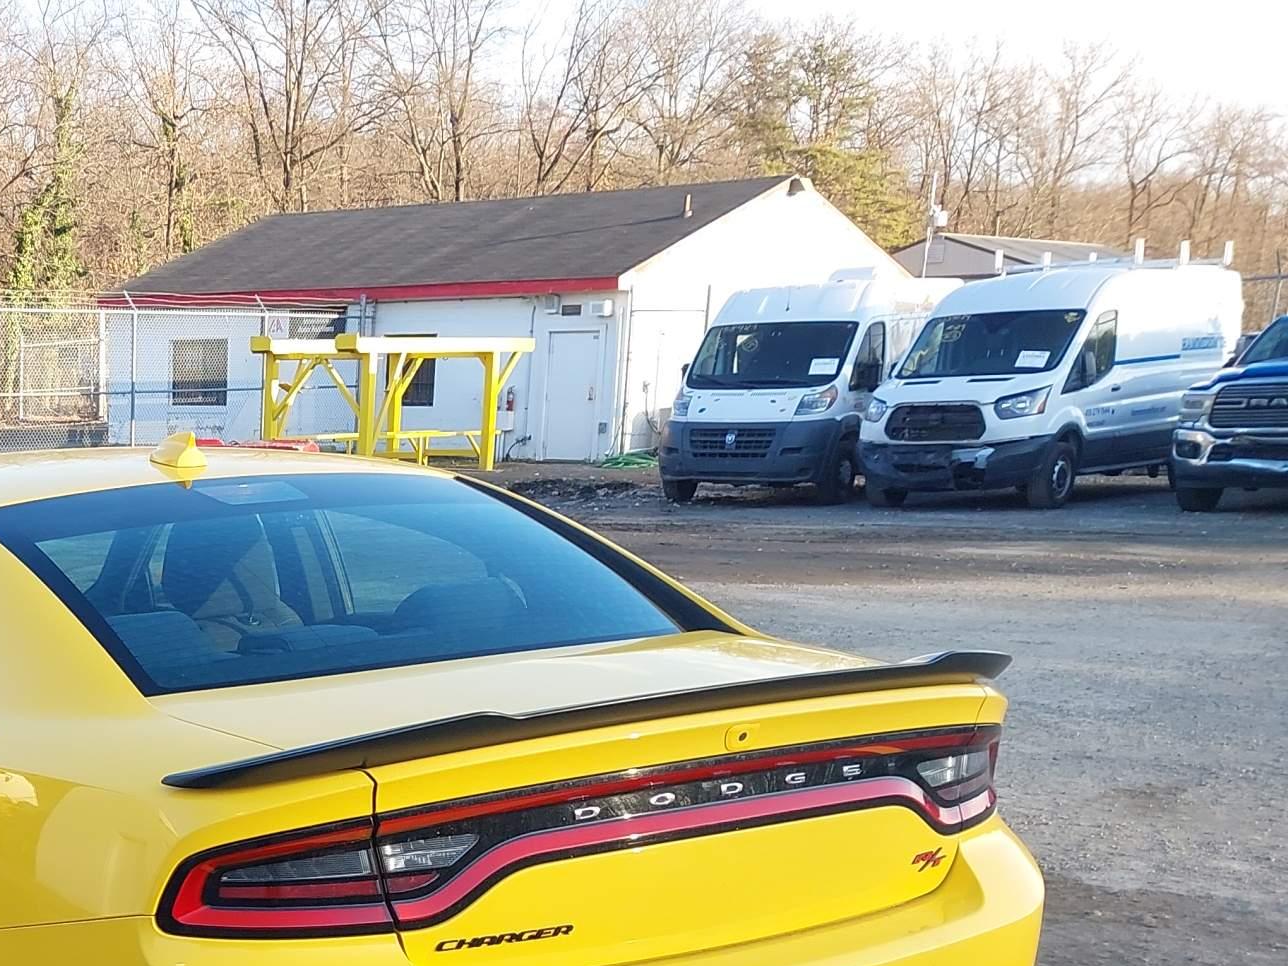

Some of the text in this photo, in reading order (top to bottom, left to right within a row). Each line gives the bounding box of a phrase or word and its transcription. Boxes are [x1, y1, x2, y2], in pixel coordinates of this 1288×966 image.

[574, 763, 862, 821] DODGE
[911, 847, 946, 872] R/T
[435, 924, 574, 952] CHARGER
